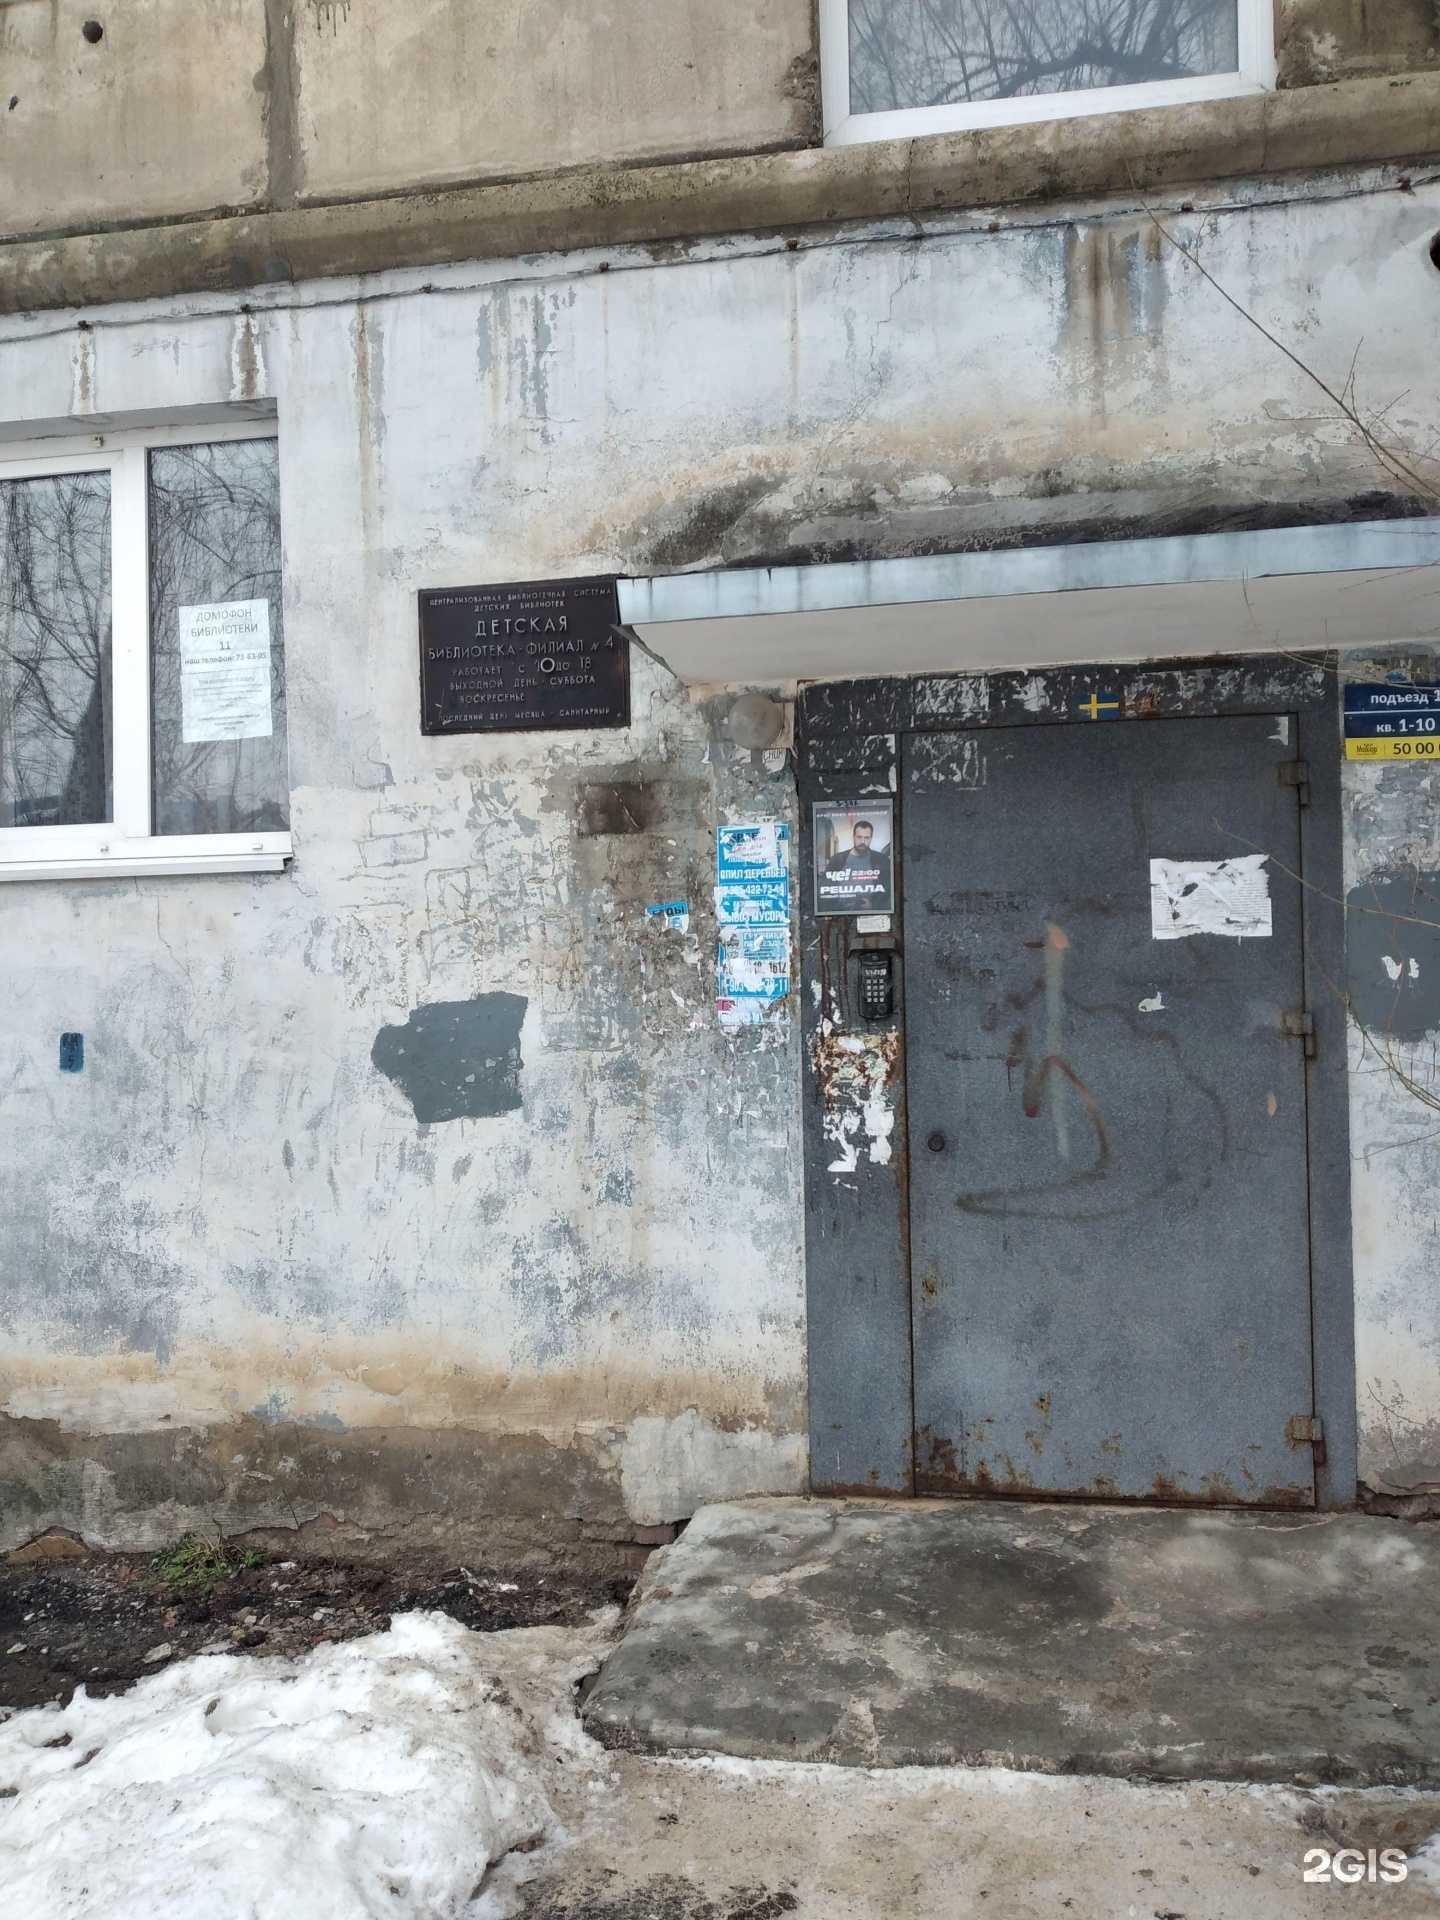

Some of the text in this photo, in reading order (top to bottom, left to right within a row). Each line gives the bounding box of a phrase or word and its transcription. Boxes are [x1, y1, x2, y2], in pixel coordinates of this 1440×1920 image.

[196, 607, 252, 623] ДОМОФОН
[191, 623, 258, 637] БИБЛИОТЕКИ
[475, 615, 567, 637] ДЕТСКАЯ
[579, 656, 591, 669] 18
[549, 674, 596, 686] СУББОТА
[1370, 694, 1429, 706] подъезд
[1376, 717, 1436, 733] кв. 1-10
[820, 884, 885, 894] РЕШАЛА
